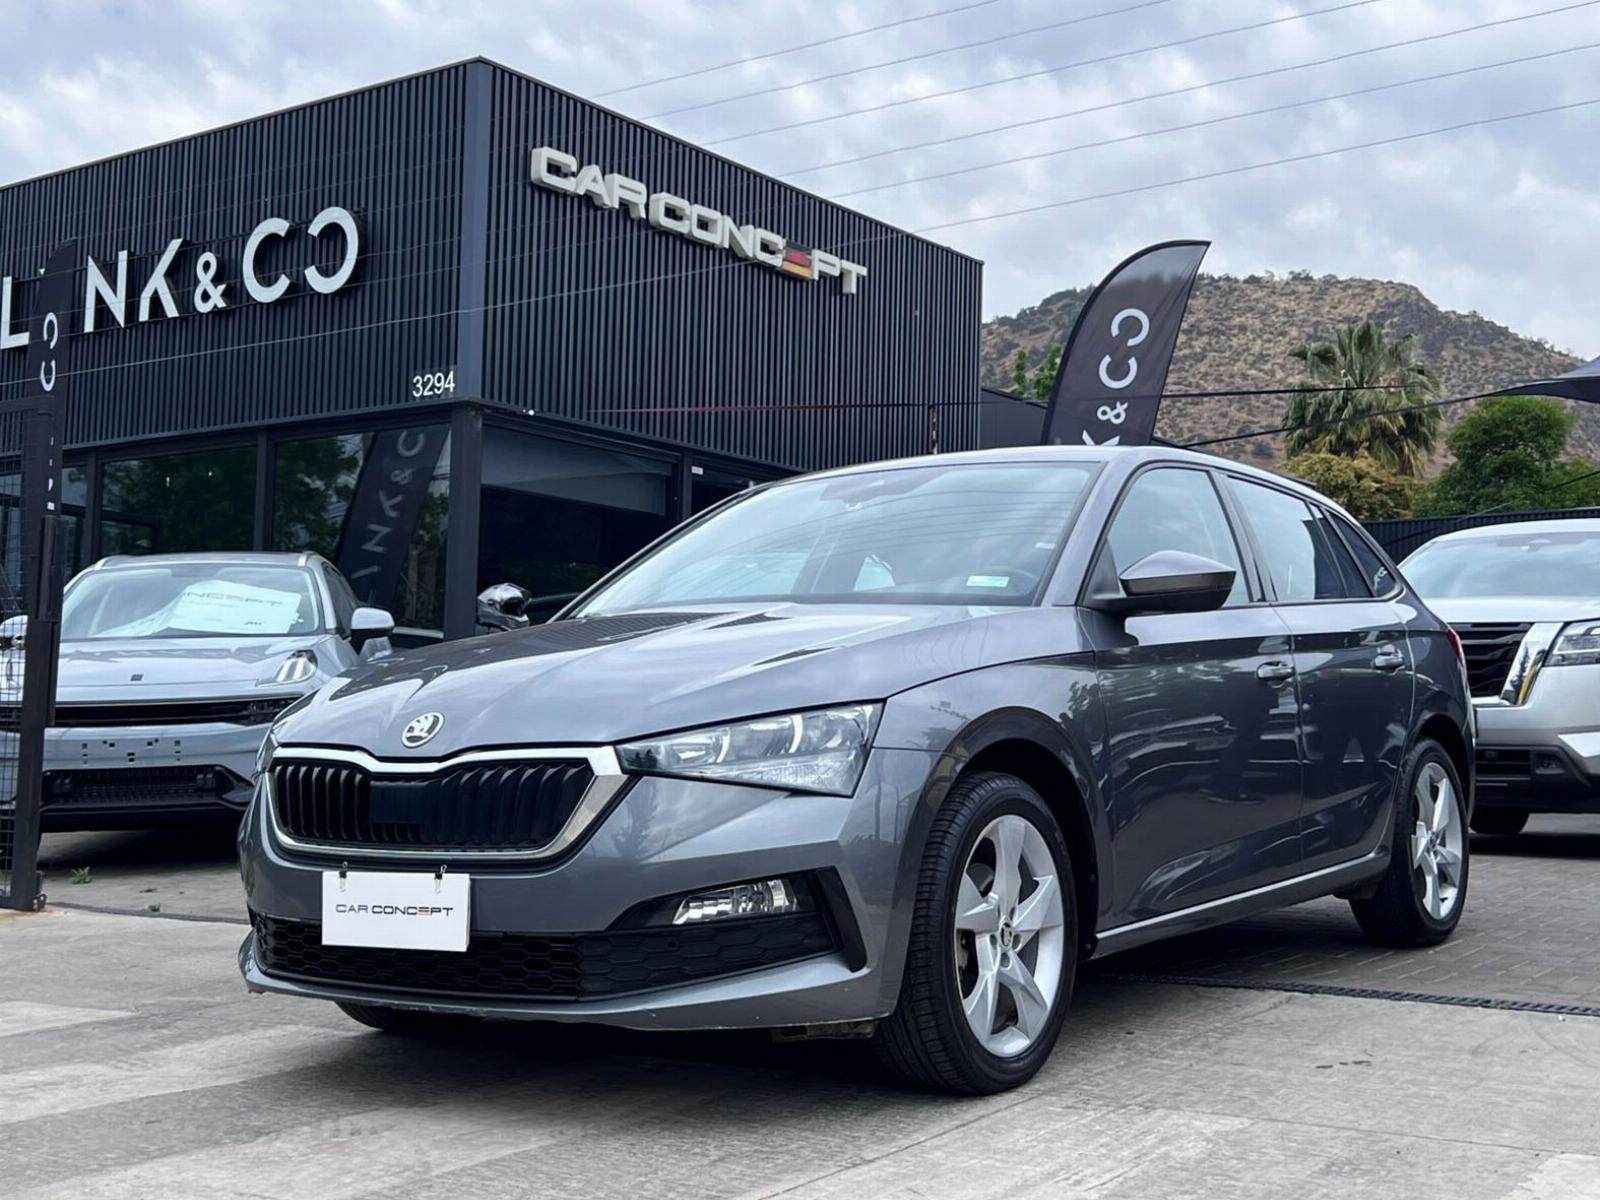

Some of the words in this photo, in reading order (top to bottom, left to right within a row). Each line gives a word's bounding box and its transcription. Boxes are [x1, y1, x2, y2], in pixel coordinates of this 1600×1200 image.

[530, 146, 647, 219] CAR
[649, 191, 868, 296] CONCEPT
[412, 370, 456, 398] 3294
[335, 903, 369, 915] CAR
[371, 905, 454, 917] CONCEPT
